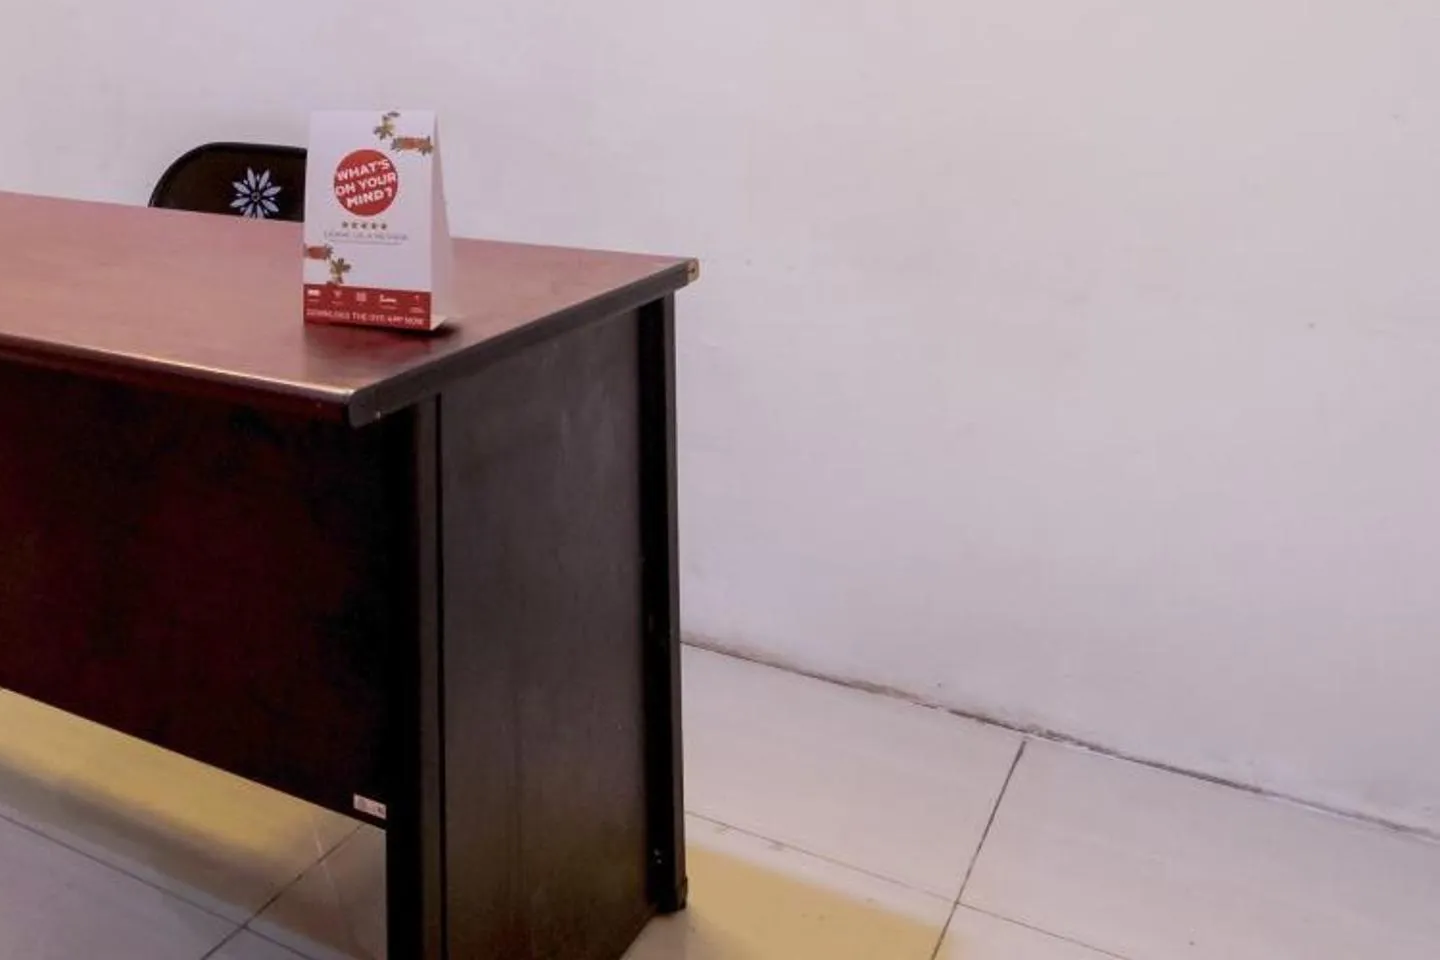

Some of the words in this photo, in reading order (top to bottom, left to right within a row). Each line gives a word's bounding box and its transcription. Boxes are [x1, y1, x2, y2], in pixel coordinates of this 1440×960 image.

[337, 159, 391, 181] WHAT'S
[335, 183, 356, 197] ON
[359, 172, 396, 191] YOUR
